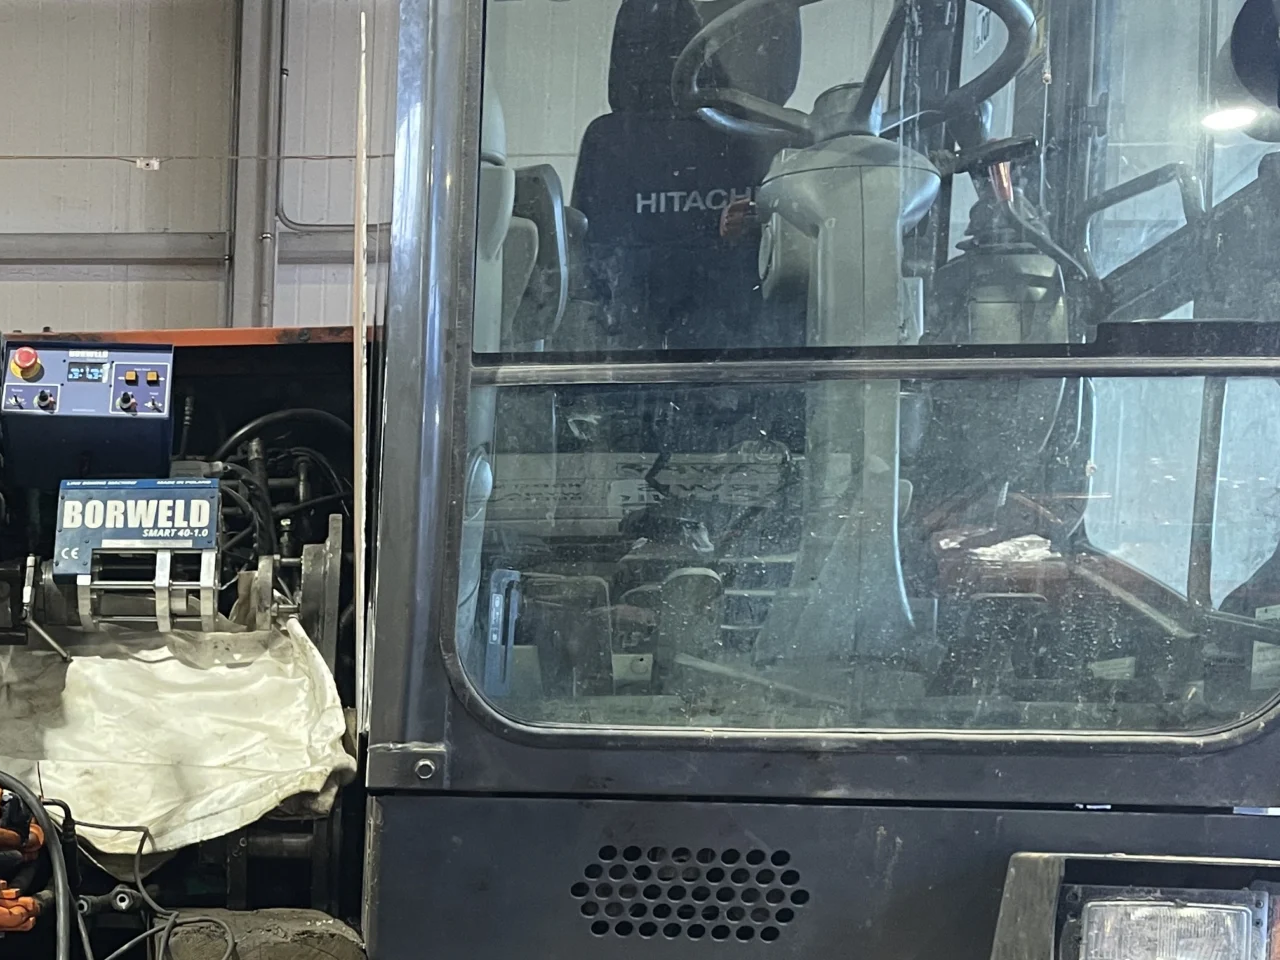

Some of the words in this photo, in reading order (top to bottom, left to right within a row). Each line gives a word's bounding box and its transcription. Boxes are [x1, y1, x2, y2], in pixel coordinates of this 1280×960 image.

[636, 187, 761, 214] HITACH
[62, 499, 210, 529] BORWELD
[142, 528, 177, 537] SMART
[177, 528, 209, 537] 40-1.0
